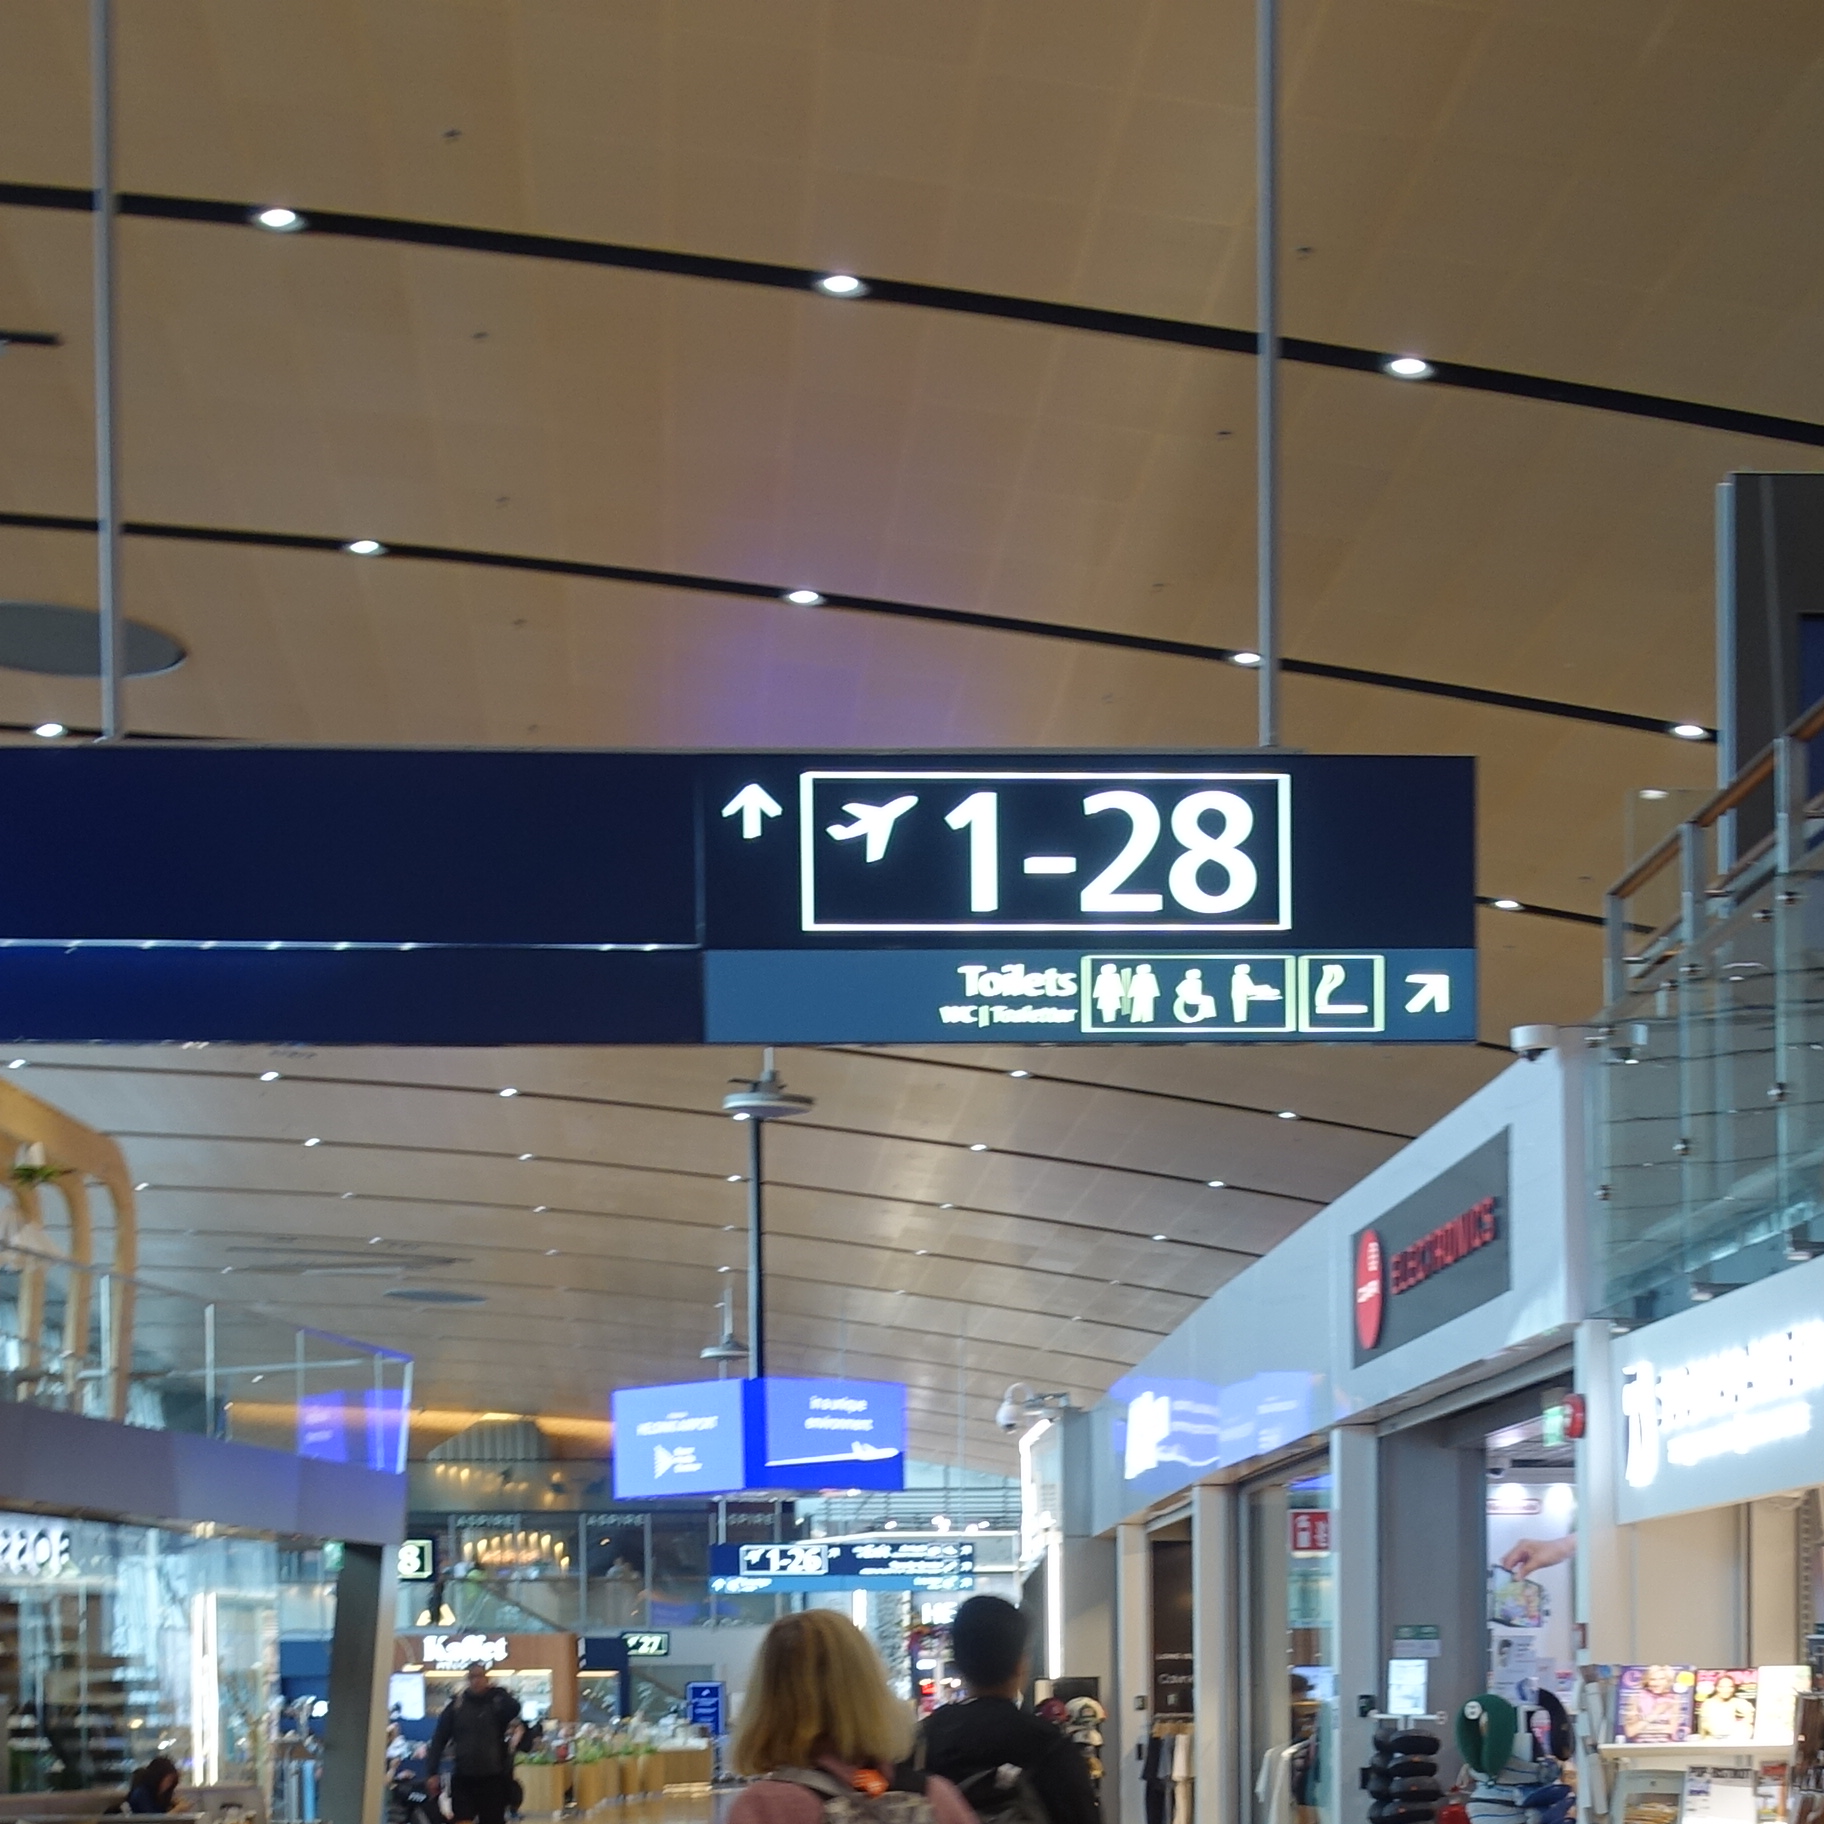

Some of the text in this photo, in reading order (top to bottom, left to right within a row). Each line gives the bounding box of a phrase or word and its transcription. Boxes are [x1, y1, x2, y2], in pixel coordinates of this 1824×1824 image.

[943, 789, 1258, 914] 1-28
[957, 963, 1078, 997] Toilets
[938, 1005, 978, 1024] WC
[1390, 1196, 1496, 1294] ELECTRONICS
